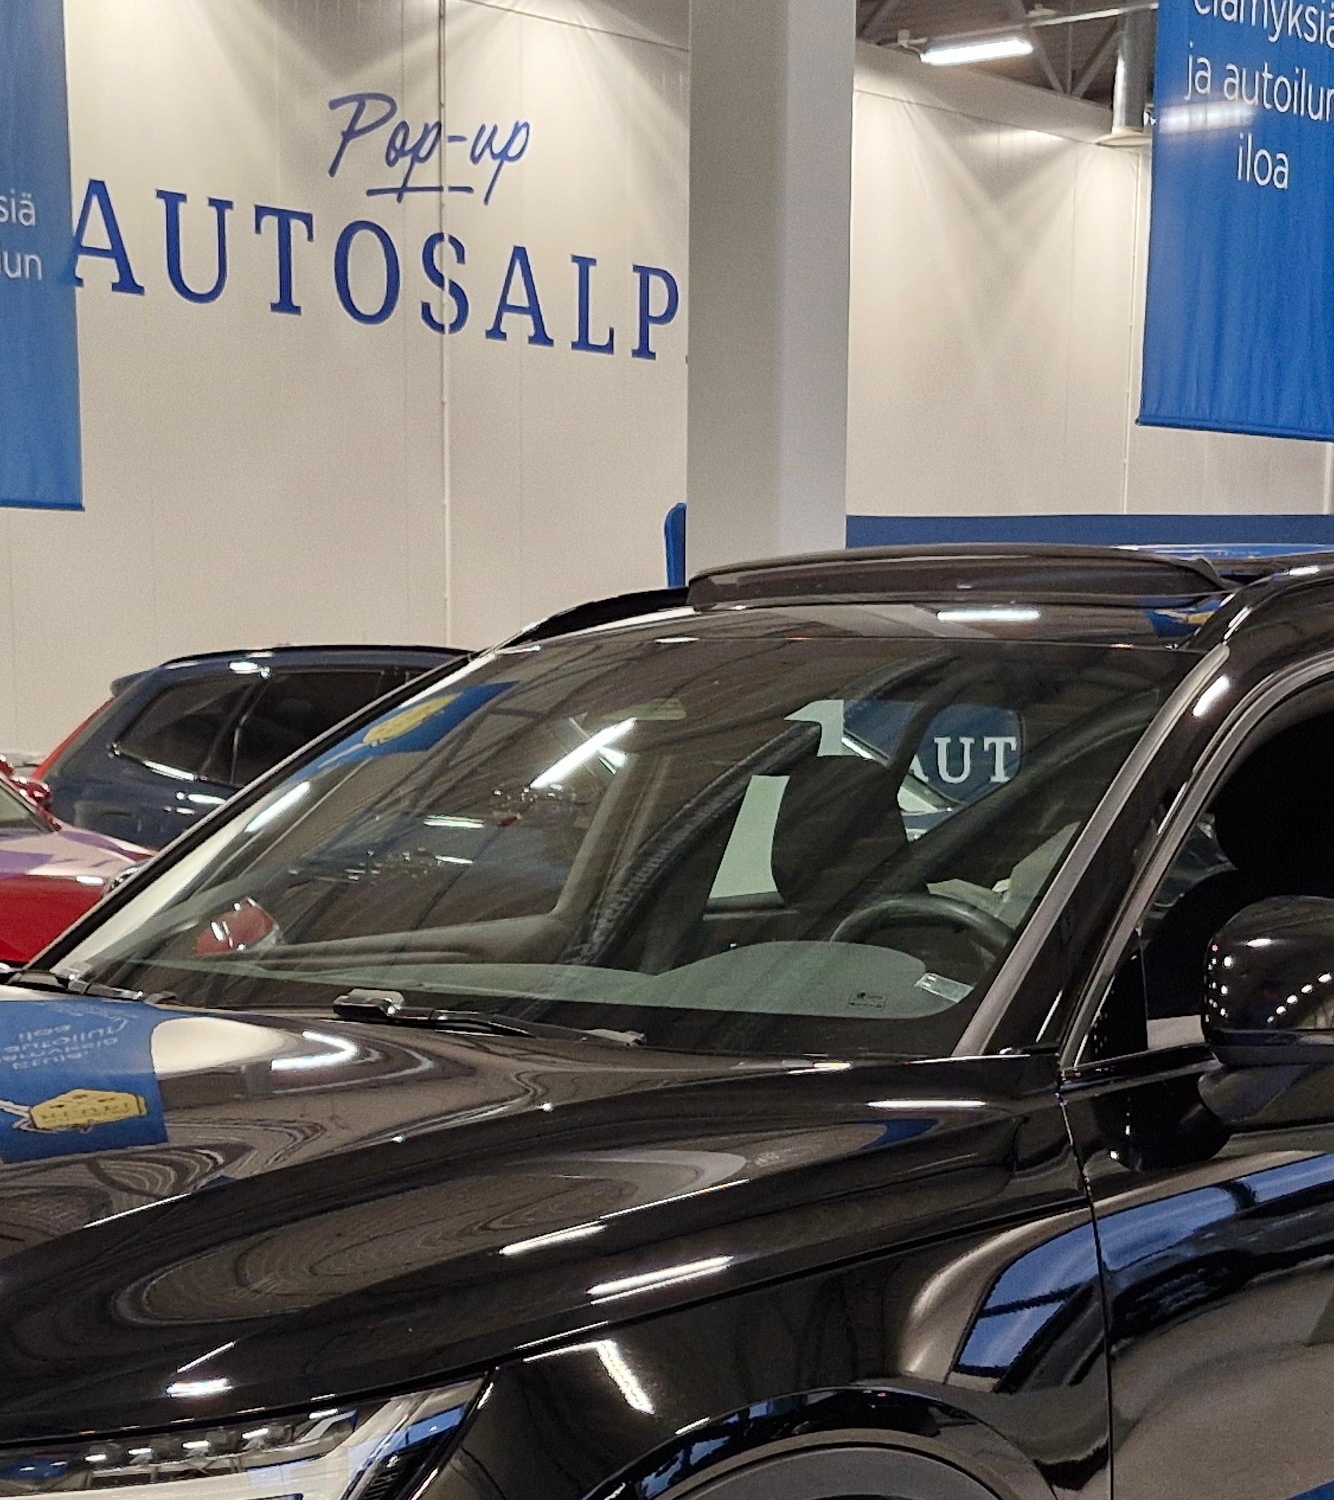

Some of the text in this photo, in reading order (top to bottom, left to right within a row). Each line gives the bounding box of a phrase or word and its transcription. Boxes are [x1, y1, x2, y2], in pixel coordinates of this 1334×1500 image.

[1184, 40, 1211, 100] ja
[328, 92, 533, 204] Pop-up
[1237, 132, 1289, 189] iloa
[72, 178, 687, 361] AUTOSALP
